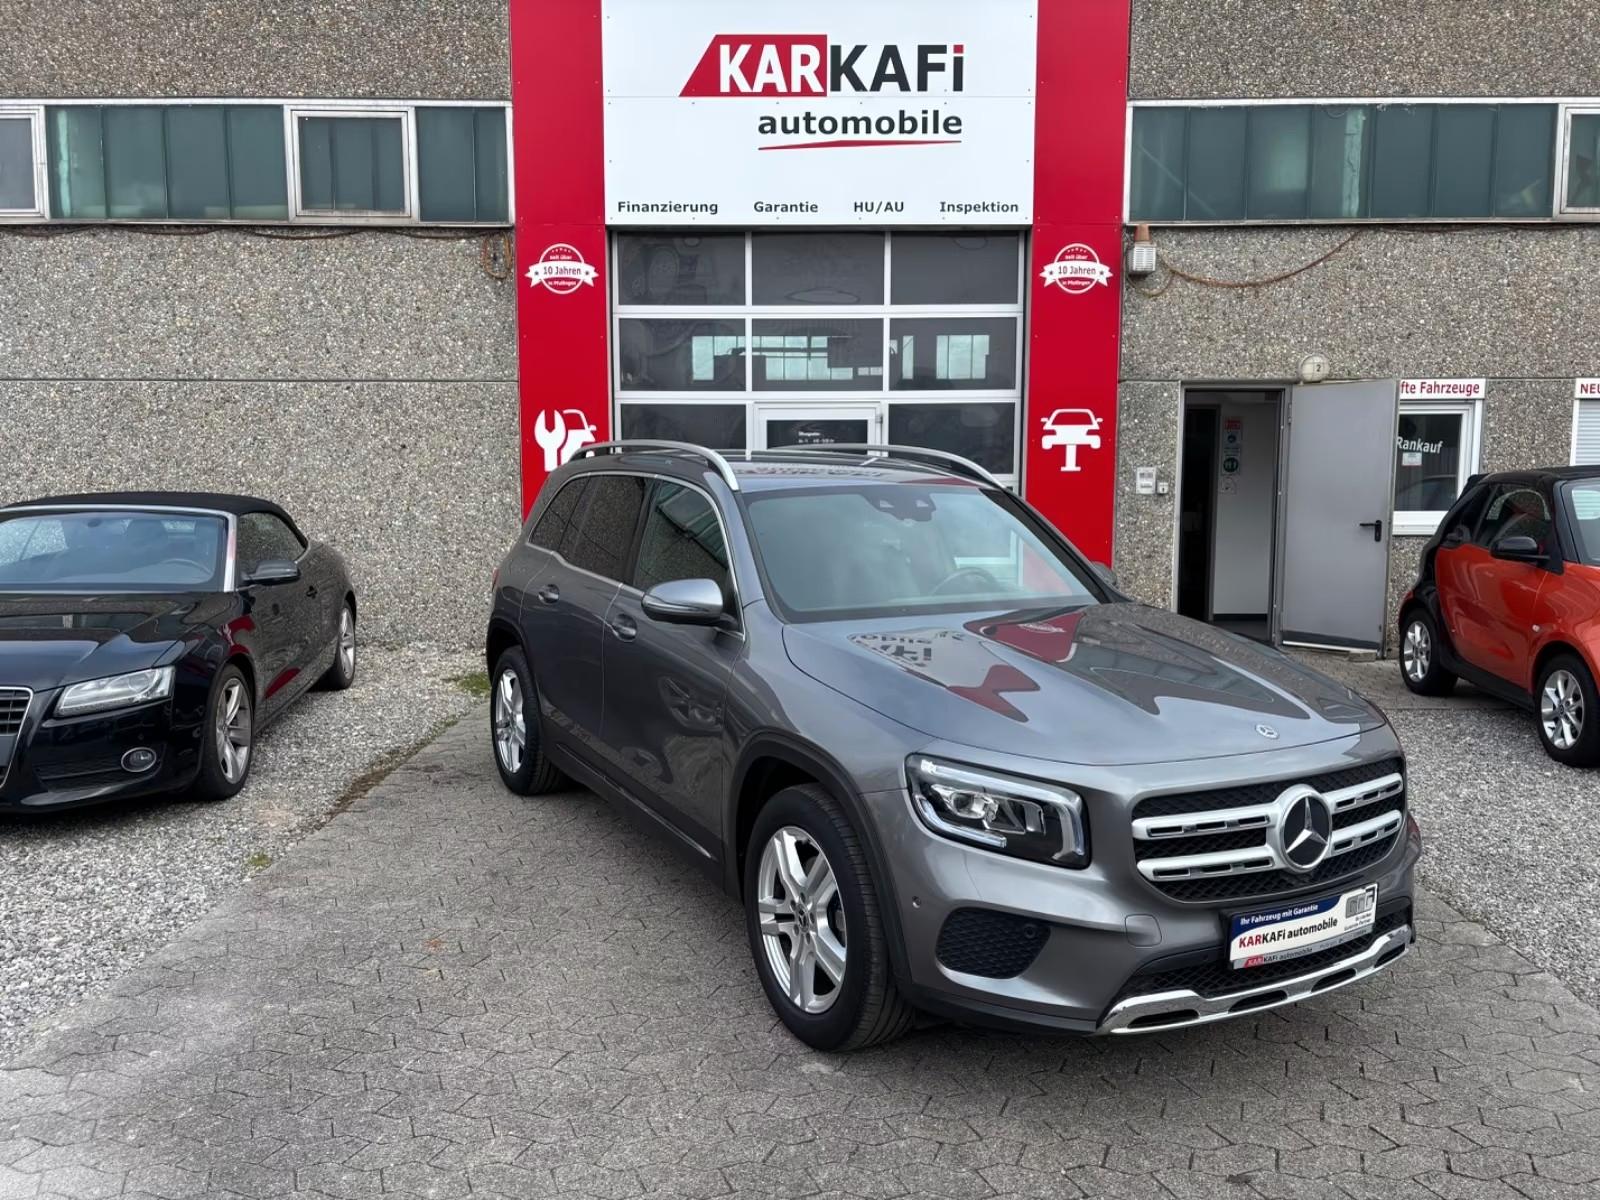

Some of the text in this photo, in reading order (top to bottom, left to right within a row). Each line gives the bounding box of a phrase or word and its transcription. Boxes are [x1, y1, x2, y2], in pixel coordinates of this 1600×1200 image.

[719, 44, 965, 93] KARKAFi
[758, 109, 963, 135] automobile
[617, 200, 1019, 215] Finanzierung Garantie HU/AU Inspektion
[543, 265, 581, 275] 10 Jahren
[1058, 265, 1096, 275] 10 Jahren
[1420, 381, 1480, 397] Fahrzeuge
[1240, 903, 1319, 926] Ihr Fahrzeug mit Garantie
[1238, 926, 1287, 949] KARKAFi
[1287, 917, 1339, 939] automobile
